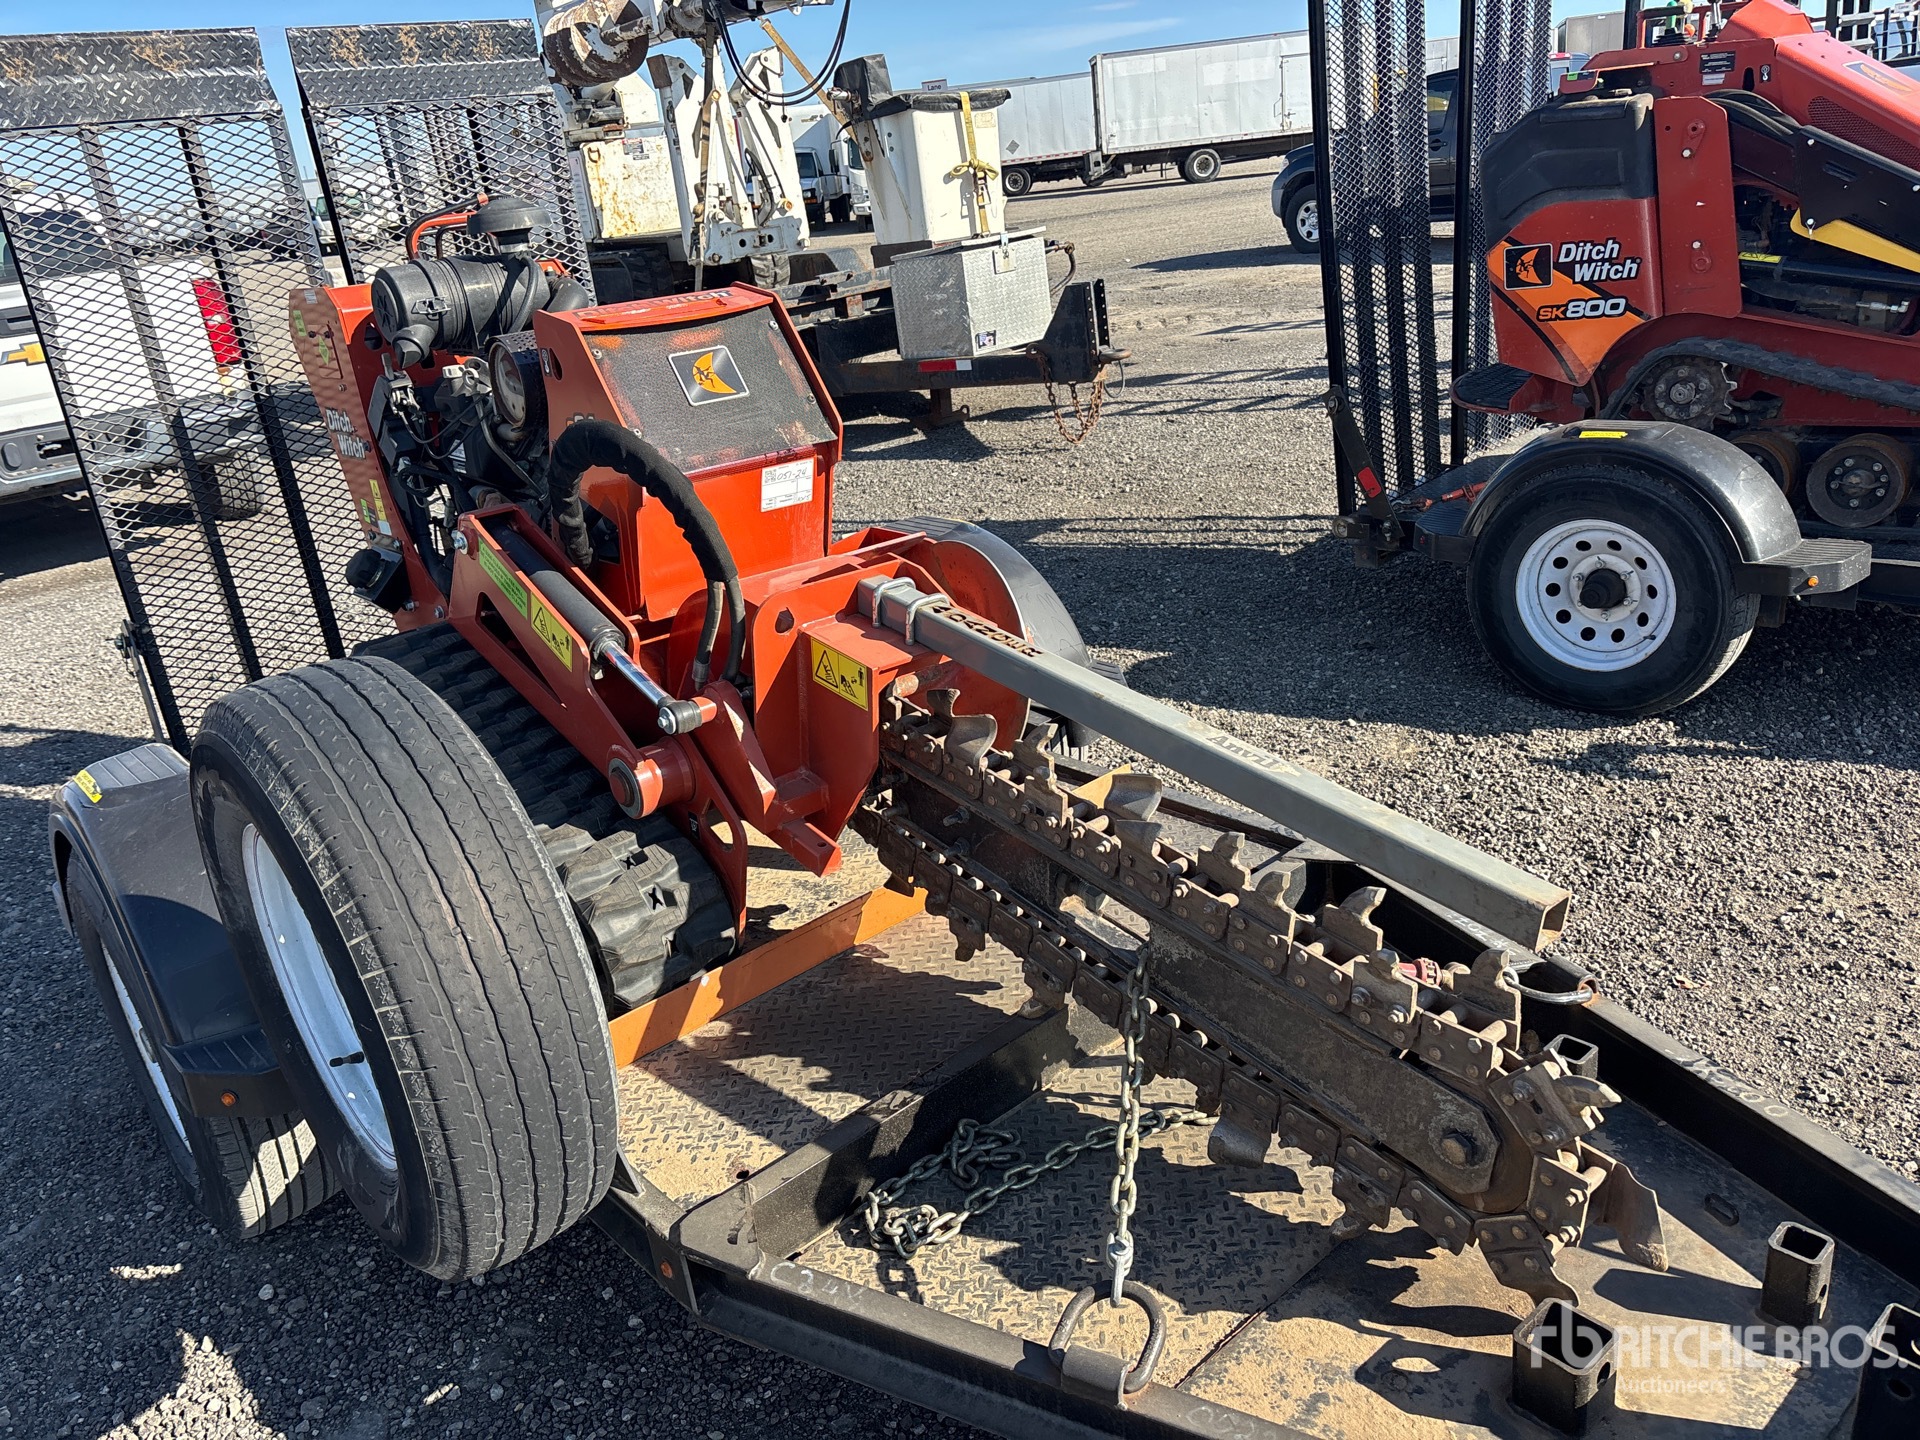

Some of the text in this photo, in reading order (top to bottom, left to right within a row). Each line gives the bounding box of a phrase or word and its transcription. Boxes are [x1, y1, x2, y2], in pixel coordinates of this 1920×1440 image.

[1558, 240, 1620, 263] Ditch
[1574, 259, 1638, 283] Witch
[1538, 298, 1627, 321] SK800
[325, 409, 353, 433] Ditch
[337, 434, 366, 459] Witch
[948, 613, 1043, 658] DANGER
[1206, 735, 1280, 769] Anvil
